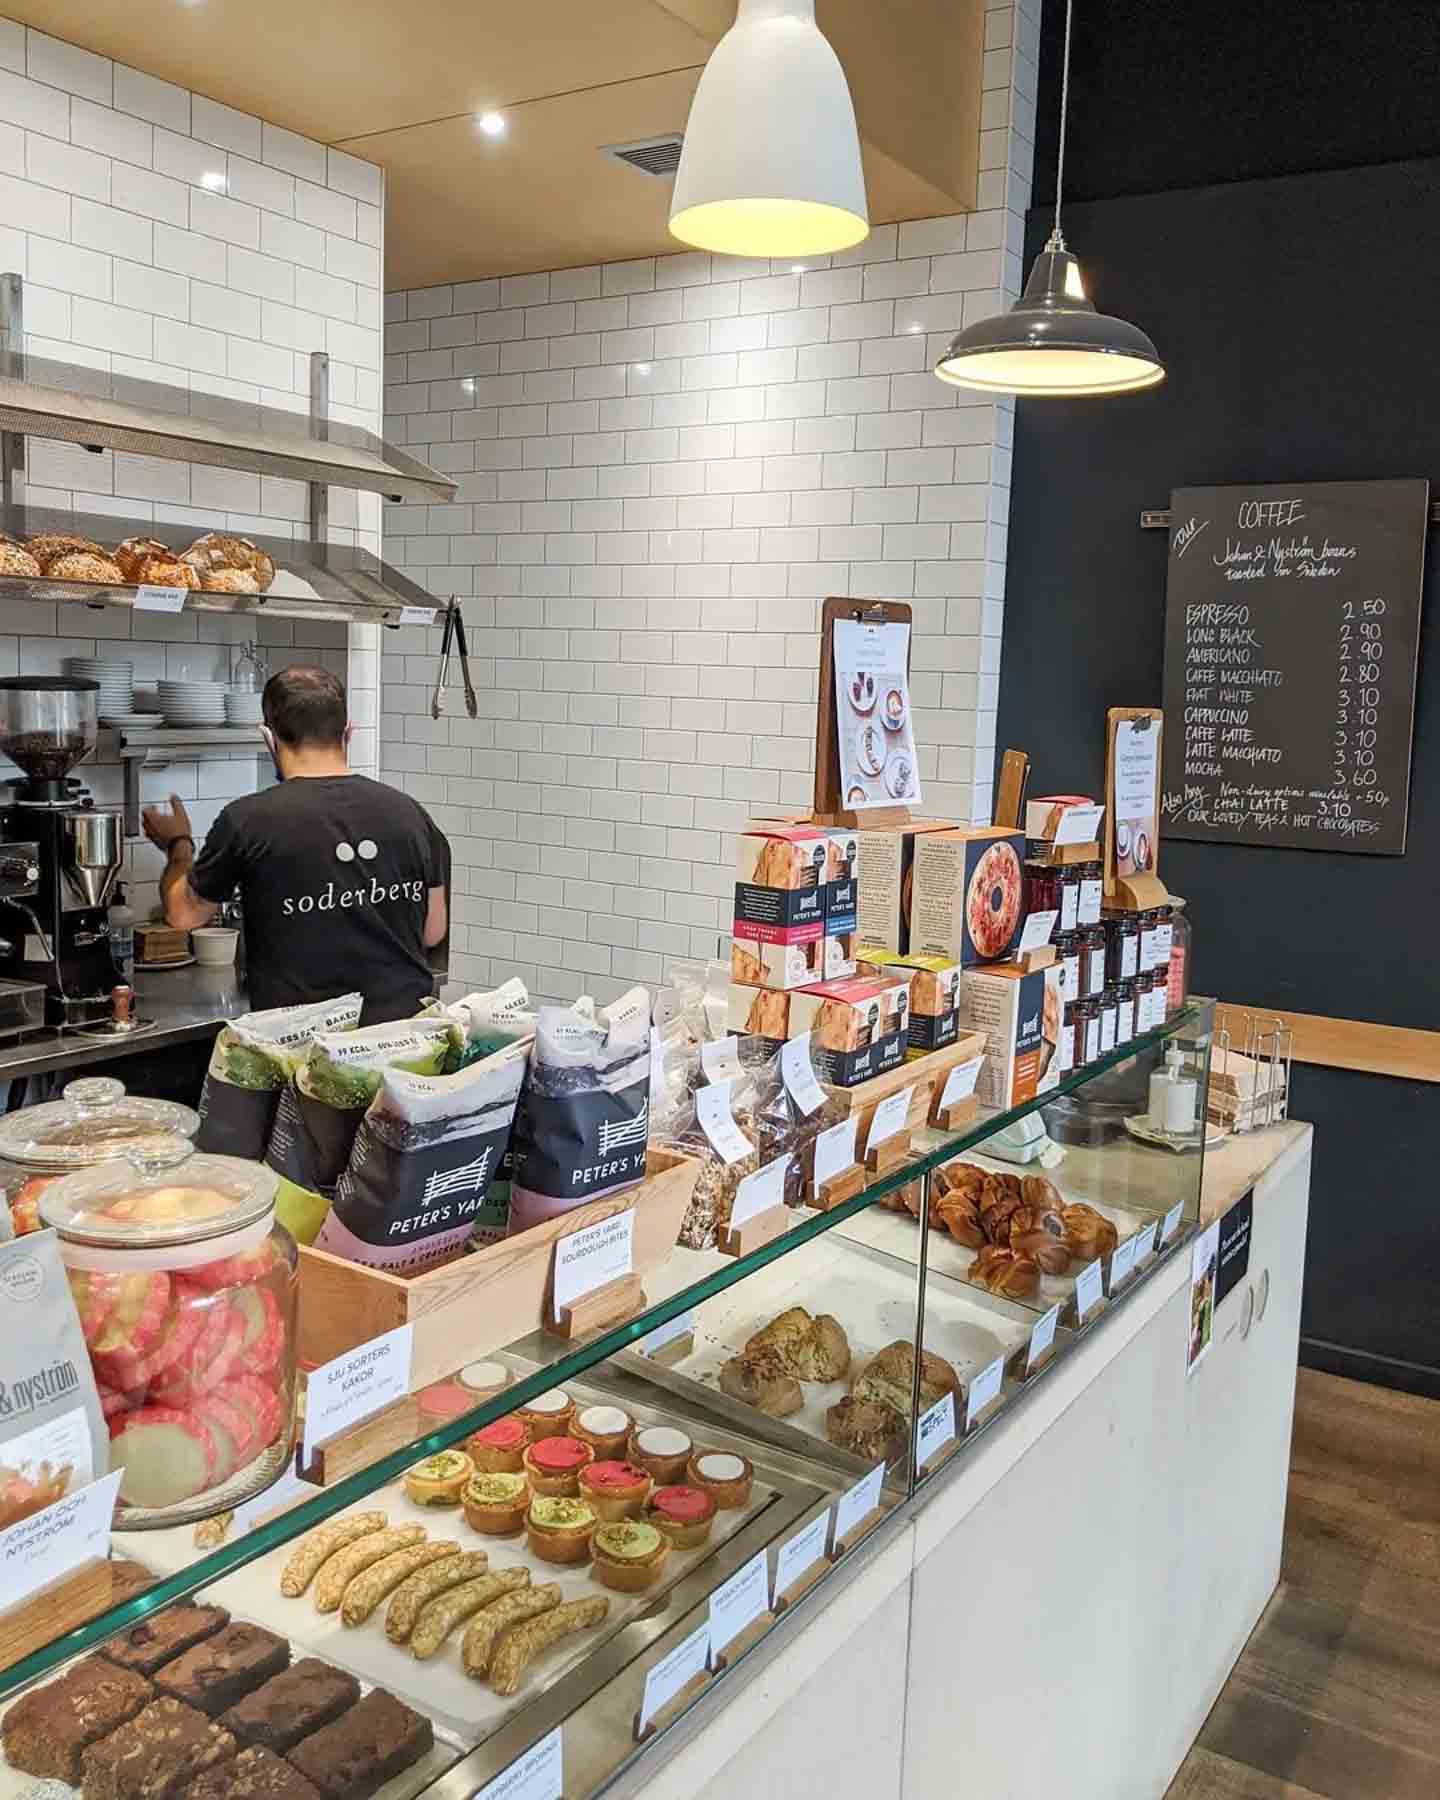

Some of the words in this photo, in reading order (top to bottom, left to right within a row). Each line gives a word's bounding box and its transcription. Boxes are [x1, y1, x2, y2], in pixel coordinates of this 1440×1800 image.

[1238, 499, 1305, 529] COFFEE
[1186, 603, 1249, 626] ESPRESSO
[1341, 598, 1386, 620] 2.50
[1187, 627, 1216, 645] LONG
[1220, 627, 1262, 648] BLACK
[1340, 623, 1382, 642] 2.90
[1186, 647, 1251, 665] AMERICANO
[1340, 641, 1383, 661] 2.90
[1340, 663, 1380, 683] 2.80
[1219, 687, 1256, 705] WHITE
[1338, 687, 1380, 707] 3.10
[1184, 706, 1249, 726] CAPPUCCINO
[1335, 708, 1378, 725] 3.10
[1220, 728, 1257, 744] LATTE
[1334, 729, 1377, 748] 3.10
[1185, 741, 1217, 759] LATTE
[1333, 749, 1375, 767] 3.10
[1185, 761, 1224, 777] MOCHA
[1213, 798, 1245, 810] CHAI
[1249, 795, 1289, 812] LATTE
[1317, 800, 1352, 818] 3.10
[1293, 815, 1317, 828] HOT
[282, 878, 424, 915] soderberg
[325, 1010, 359, 1027] BAKED
[571, 1157, 628, 1185] PETER'S
[388, 1205, 452, 1236] PETER'S
[13, 1359, 80, 1412] nyström
